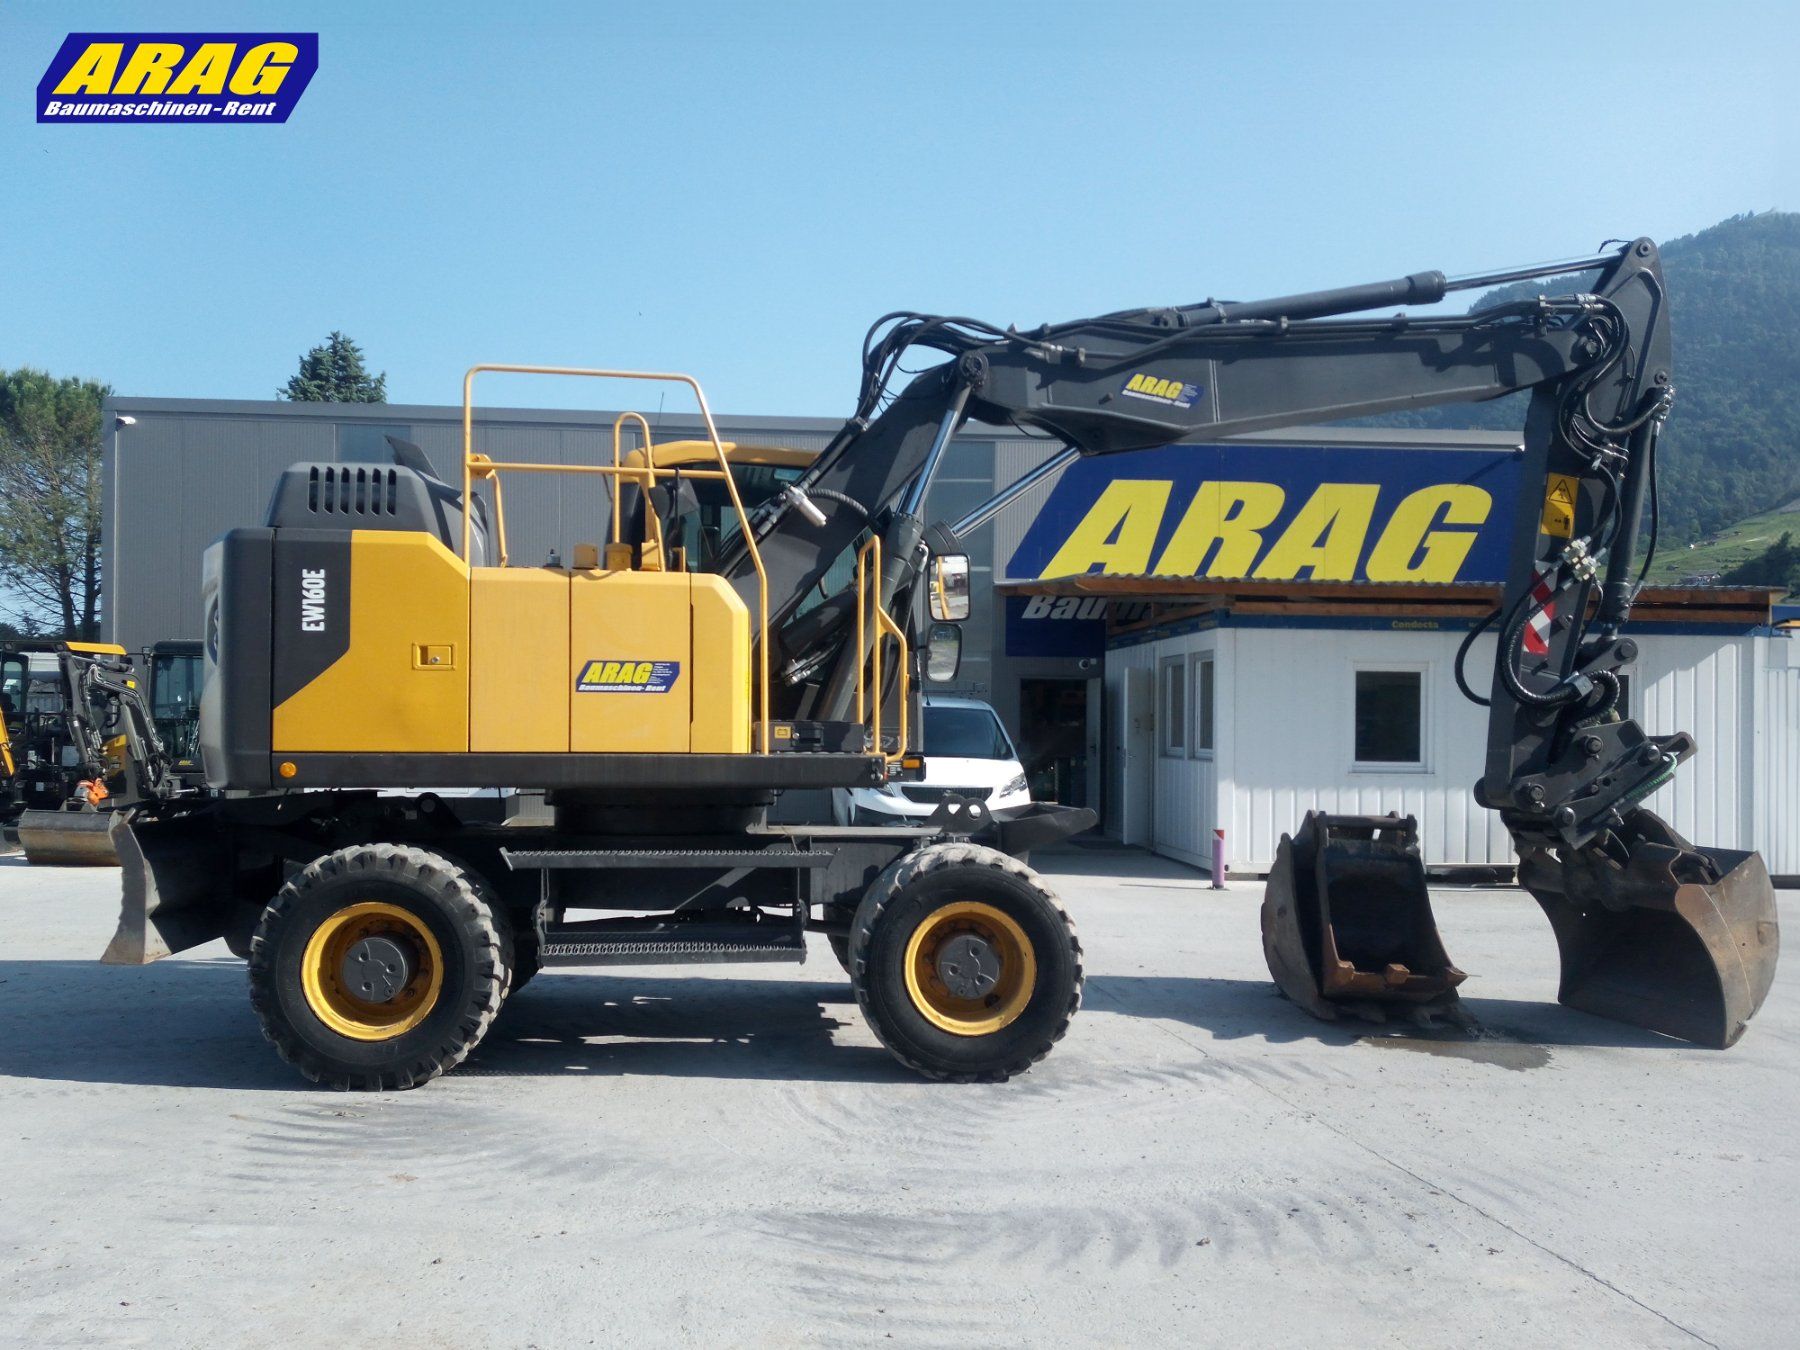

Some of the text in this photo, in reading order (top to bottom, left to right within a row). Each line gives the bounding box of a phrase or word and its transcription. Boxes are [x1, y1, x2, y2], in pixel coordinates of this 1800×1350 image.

[1125, 373, 1184, 399] ARAG
[1039, 479, 1493, 583] ARAG
[302, 569, 325, 631] EW160E
[581, 662, 653, 684] ARAG
